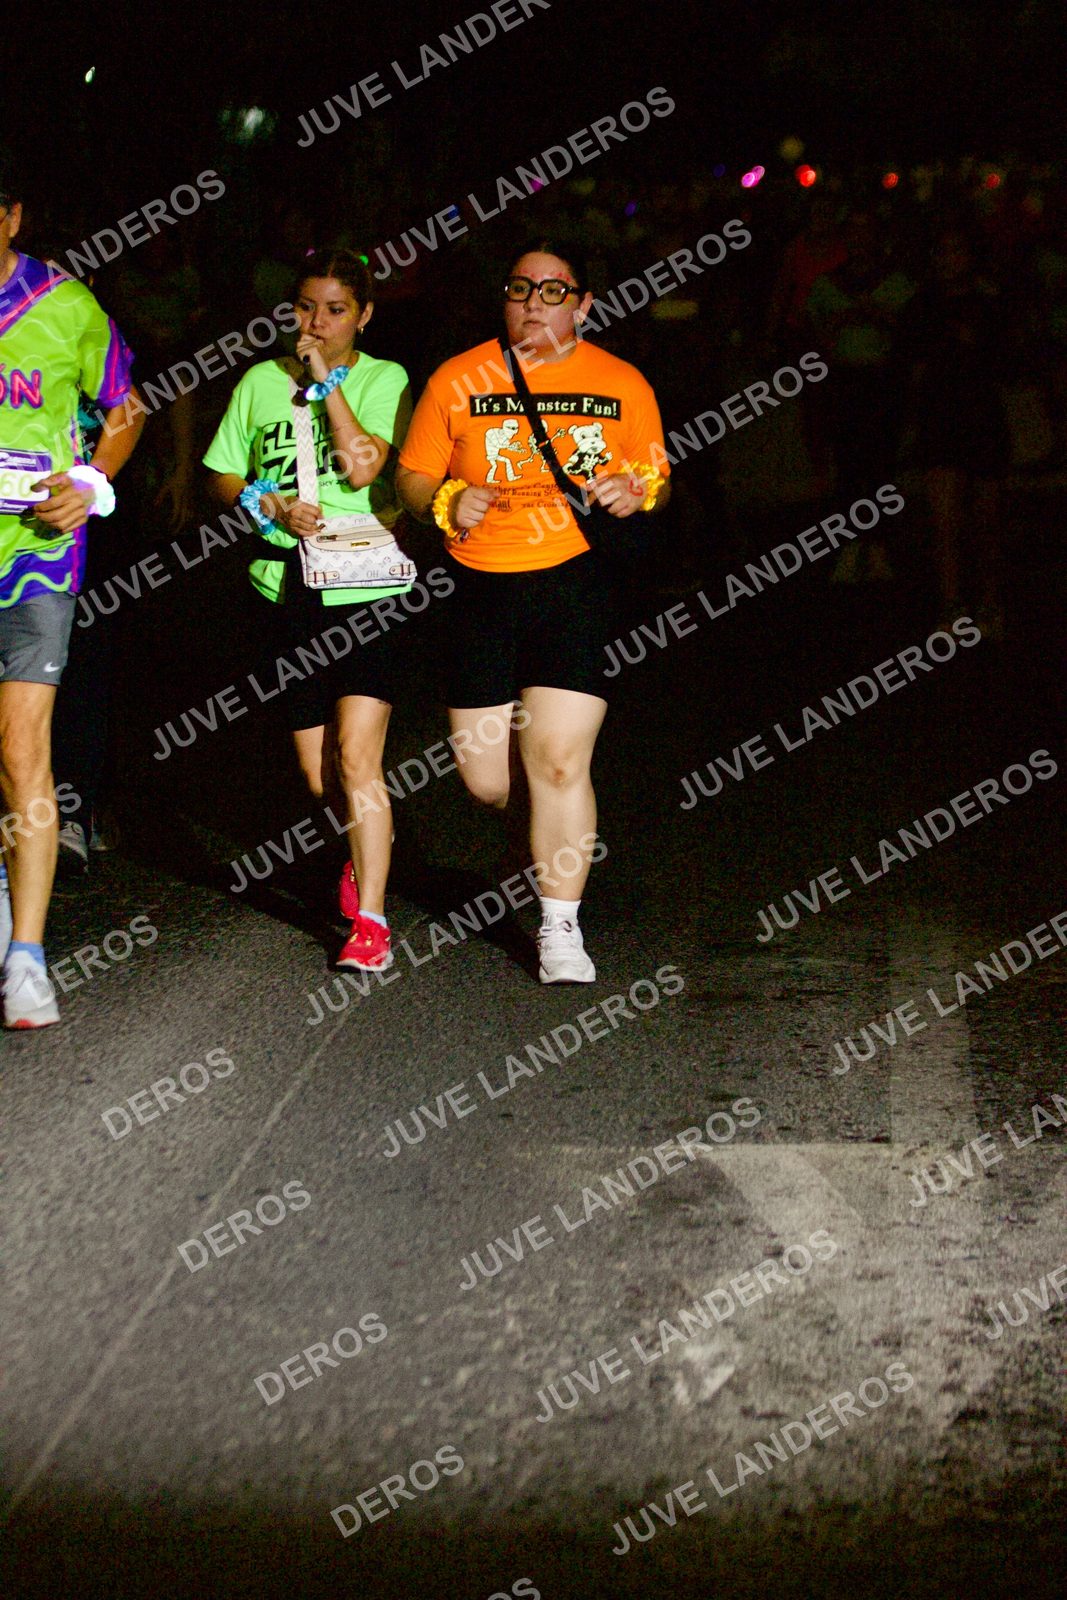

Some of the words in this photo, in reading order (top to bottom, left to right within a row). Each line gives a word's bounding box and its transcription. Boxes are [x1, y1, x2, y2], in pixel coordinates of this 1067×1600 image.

[0, 363, 43, 409] N
[474, 398, 500, 414] It's
[505, 398, 577, 413] Mnster
[582, 397, 618, 416] Fun!
